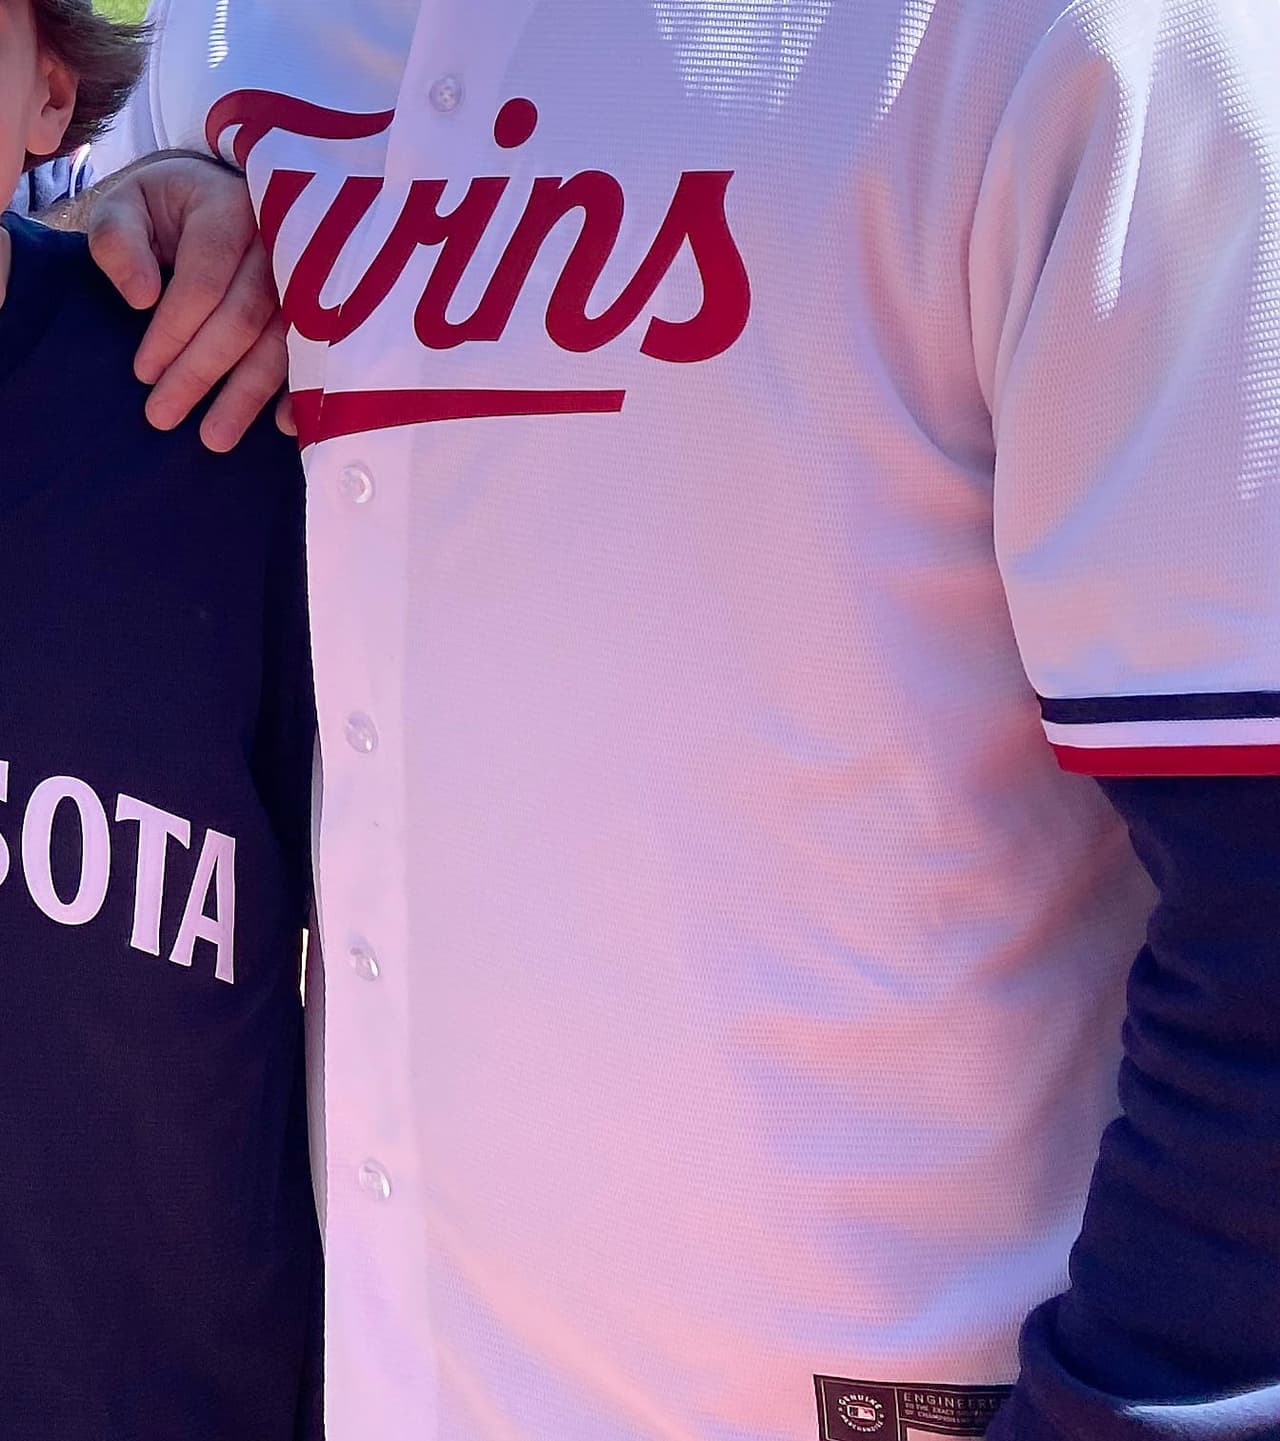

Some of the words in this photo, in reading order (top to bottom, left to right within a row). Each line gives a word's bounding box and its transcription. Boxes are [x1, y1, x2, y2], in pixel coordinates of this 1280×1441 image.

[205, 88, 752, 363] Twins
[838, 1393, 883, 1411] GENUINE
[903, 1392, 1006, 1411] ENGINEER
